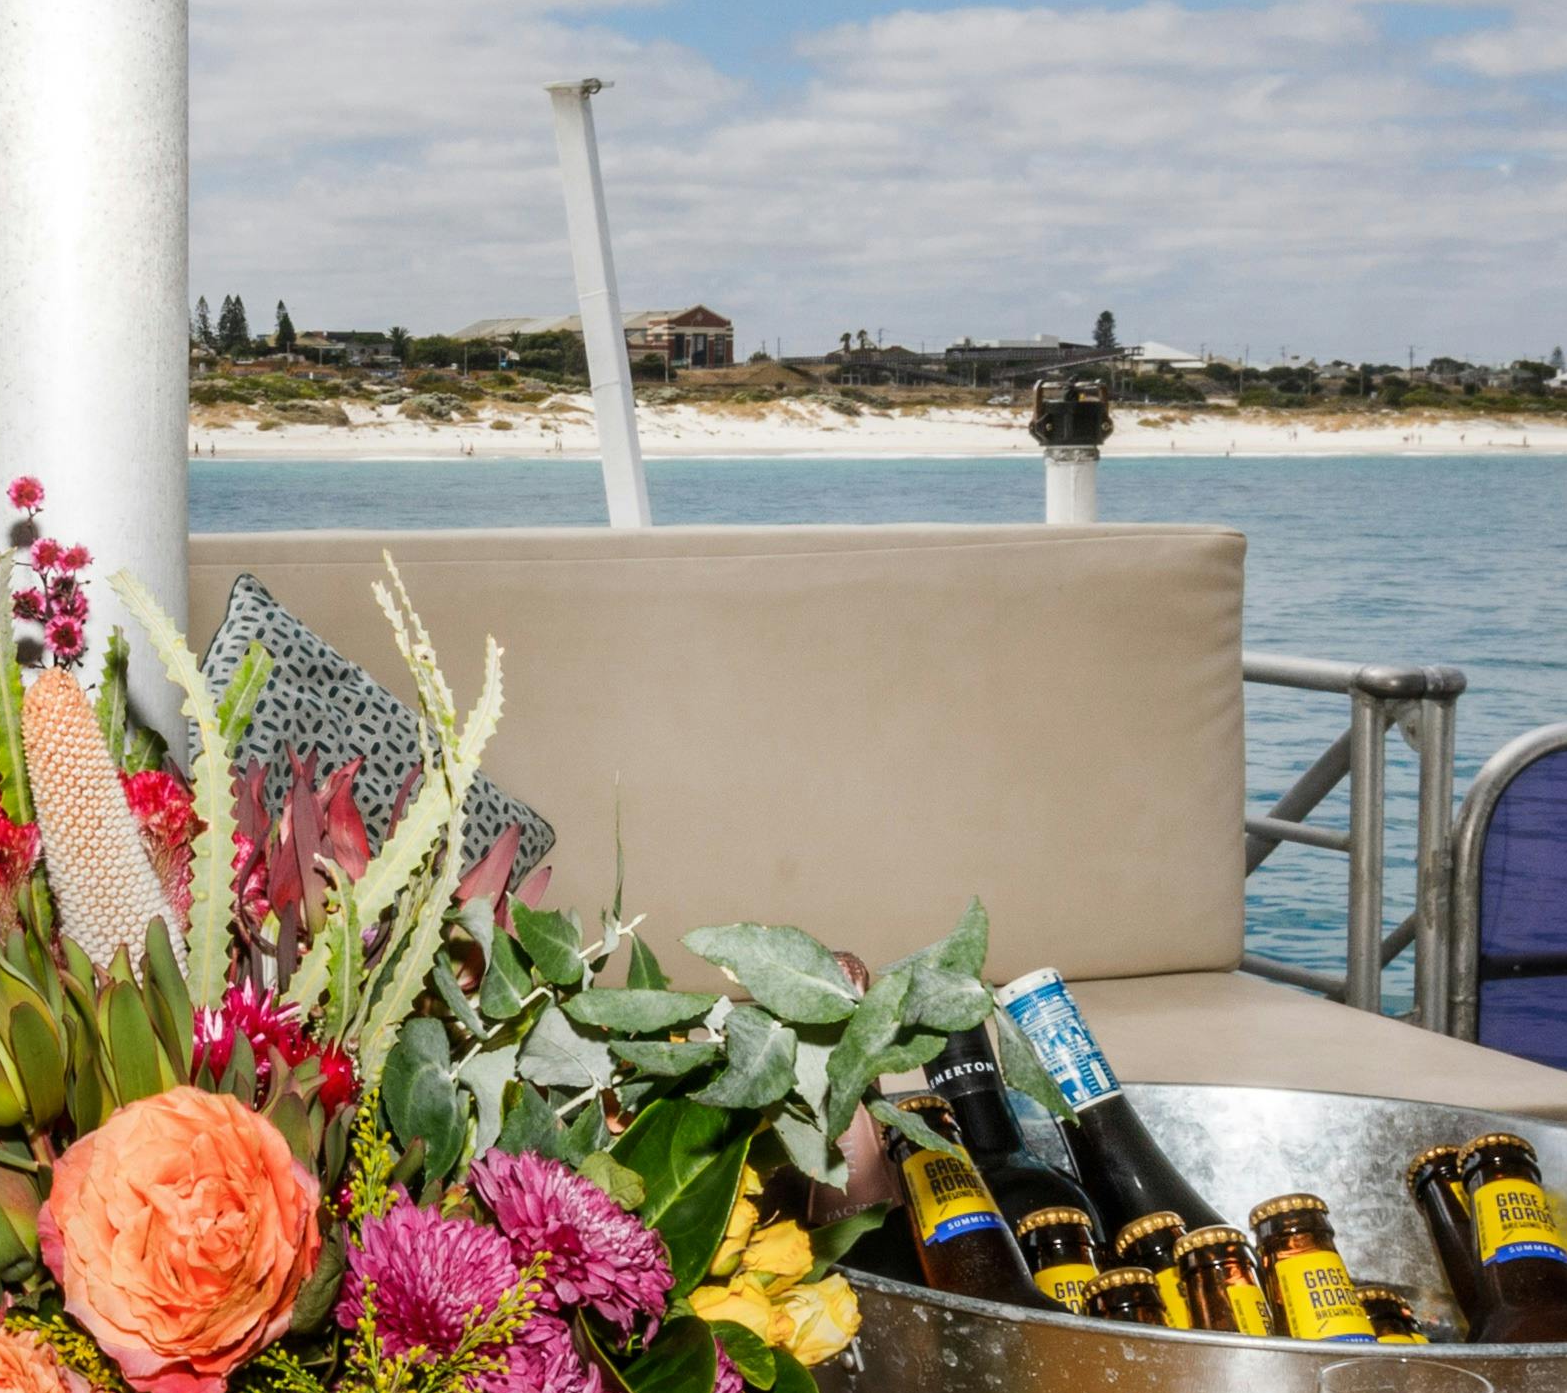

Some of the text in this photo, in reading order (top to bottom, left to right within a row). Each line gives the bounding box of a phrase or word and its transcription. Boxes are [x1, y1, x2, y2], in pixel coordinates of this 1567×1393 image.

[1496, 1187, 1539, 1207] GAGE
[947, 1215, 992, 1231] SUMMER
[1508, 1244, 1555, 1254] SUMMER
[1304, 1268, 1349, 1288] GAGE
